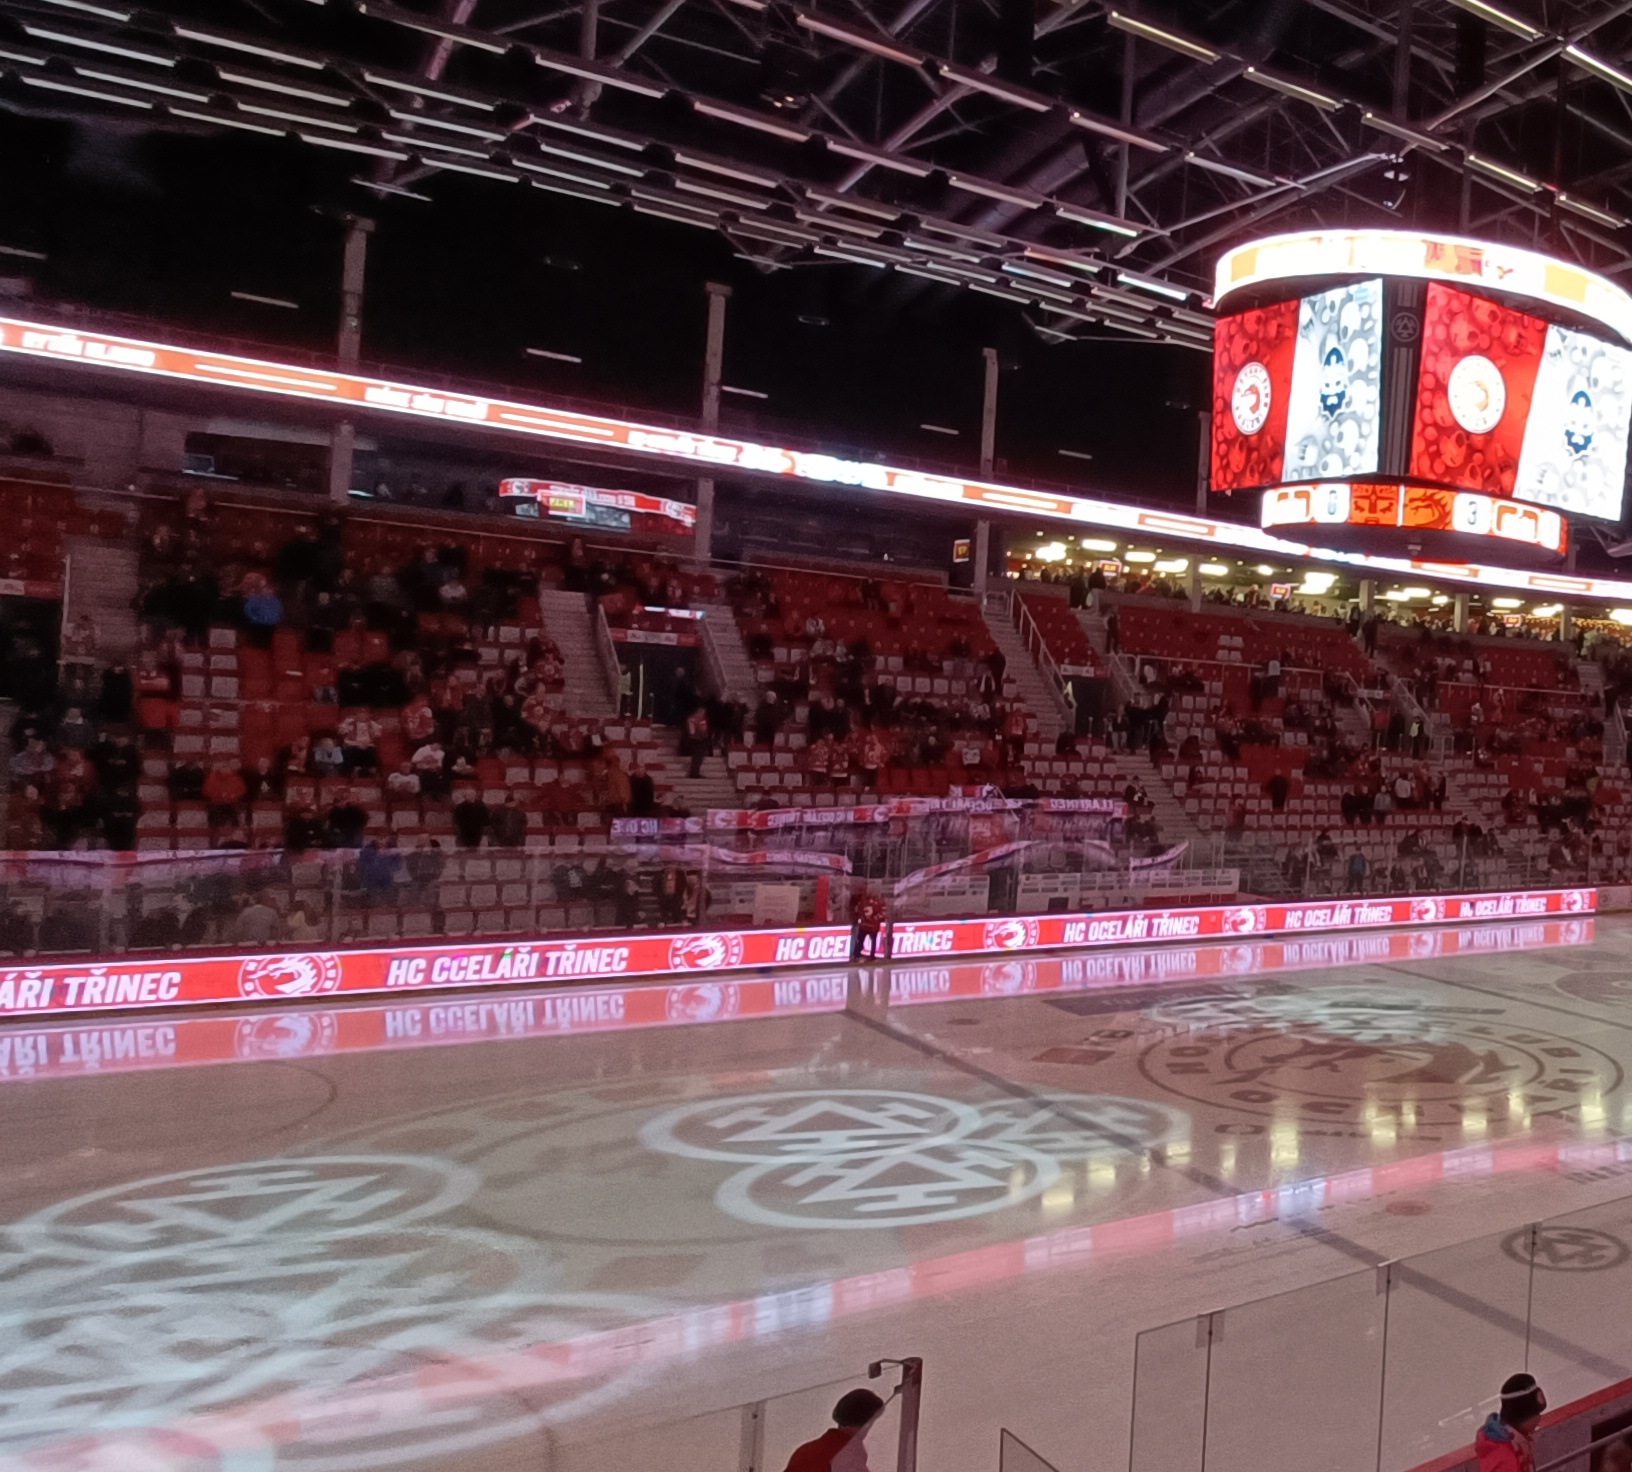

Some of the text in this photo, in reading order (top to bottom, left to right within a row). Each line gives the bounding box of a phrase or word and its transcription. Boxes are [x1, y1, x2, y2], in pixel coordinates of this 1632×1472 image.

[1467, 501, 1478, 525] 3
[1064, 913, 1200, 942] HC OCELÁŘI TŘINEC
[1284, 903, 1392, 928] HC OCELÁŘI TŘINEC
[775, 938, 801, 962] HC
[892, 926, 954, 954] TŘINEC
[387, 958, 427, 986] HC
[545, 944, 630, 975] TŘINEC
[63, 968, 182, 1006] TŘINEC
